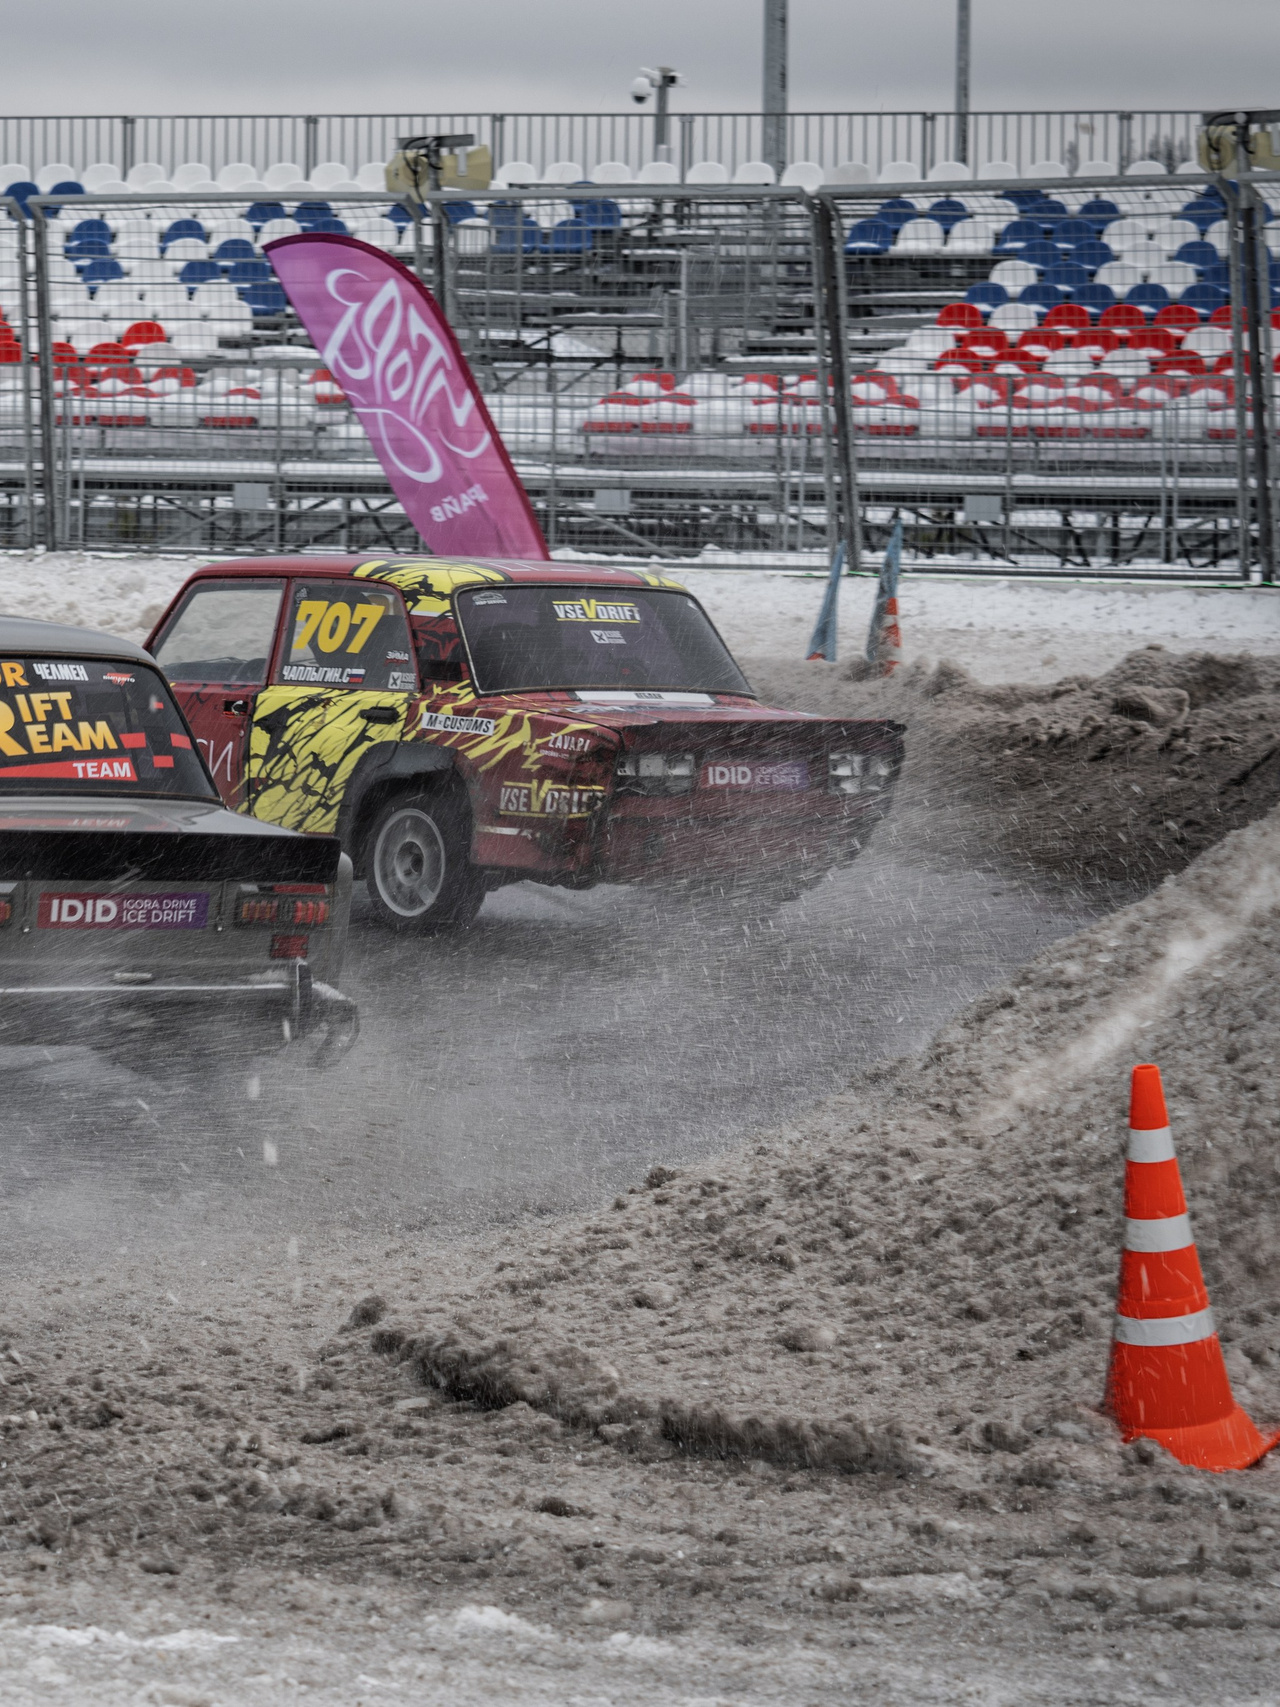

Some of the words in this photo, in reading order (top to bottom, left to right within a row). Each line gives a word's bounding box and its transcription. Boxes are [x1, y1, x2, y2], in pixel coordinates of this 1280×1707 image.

[290, 600, 386, 654] 707
[72, 762, 132, 779] TEAM
[707, 765, 752, 785] IDID
[50, 899, 118, 923] IDID
[123, 899, 160, 910] IGORA
[162, 898, 197, 910] DRIVE
[122, 910, 147, 923] ICE
[150, 909, 196, 923] DRIFT
